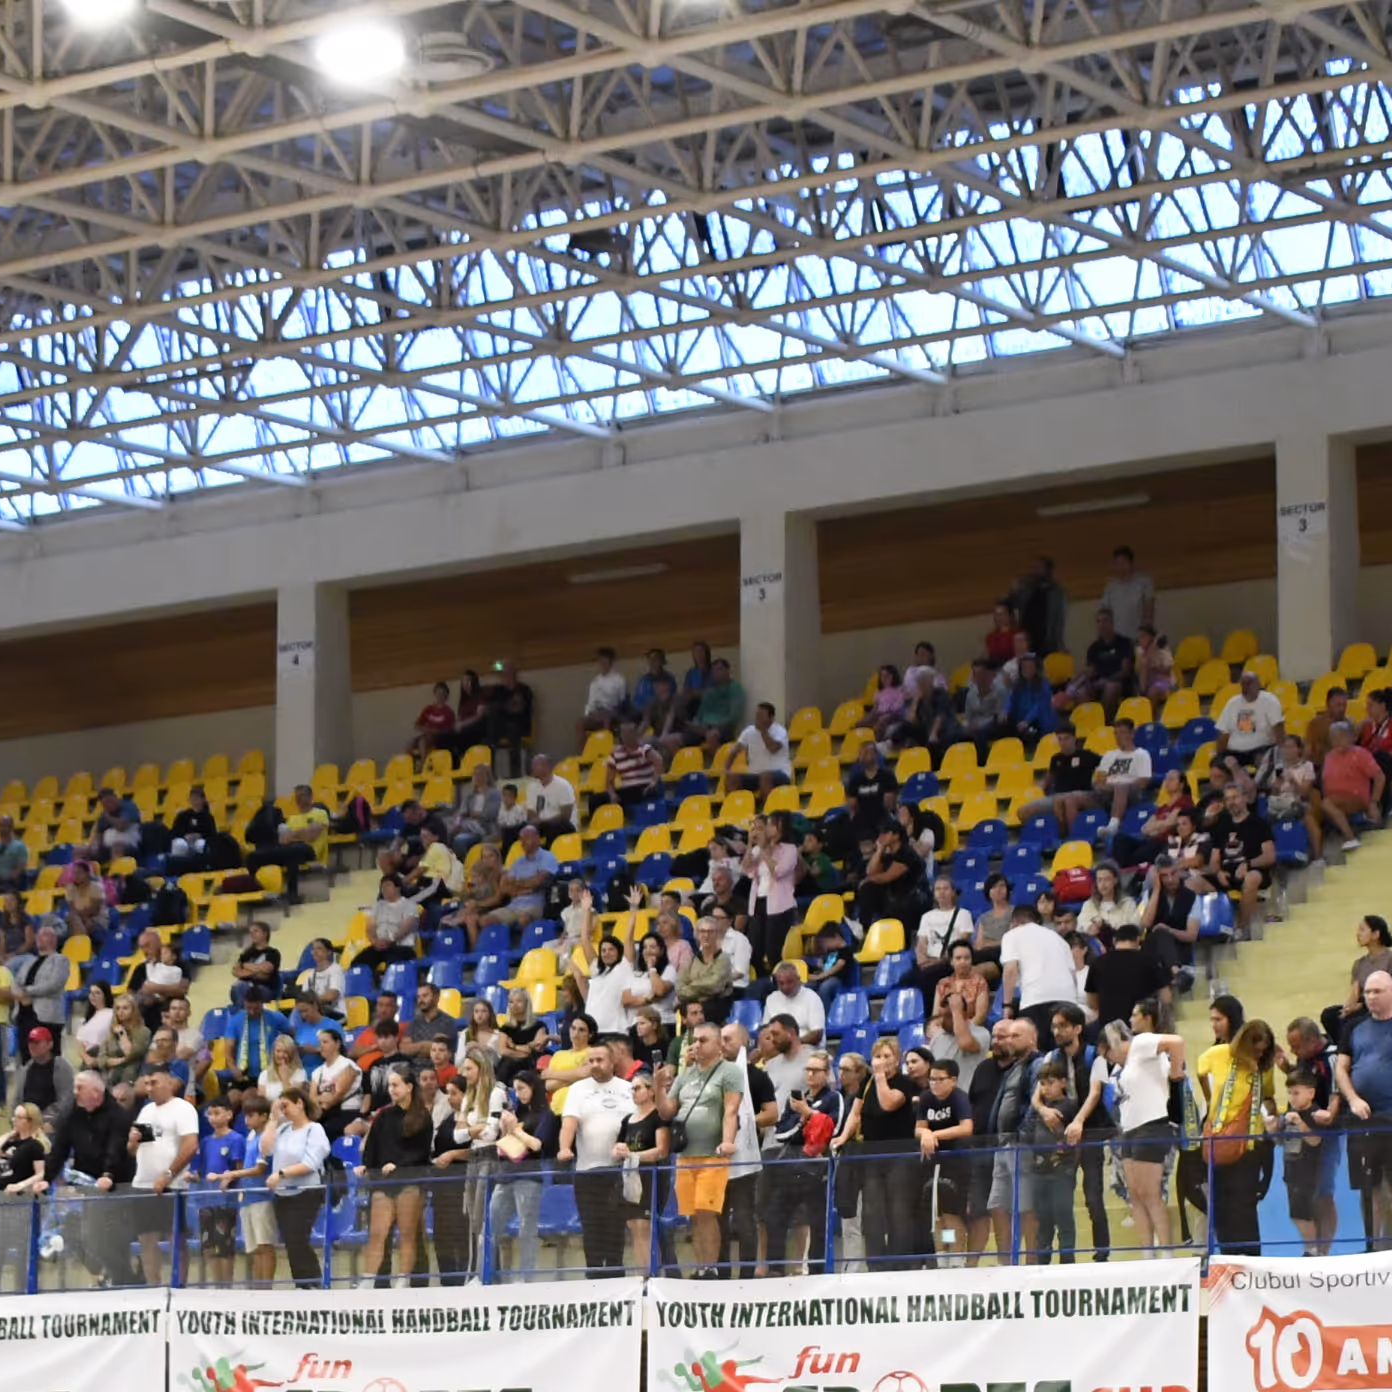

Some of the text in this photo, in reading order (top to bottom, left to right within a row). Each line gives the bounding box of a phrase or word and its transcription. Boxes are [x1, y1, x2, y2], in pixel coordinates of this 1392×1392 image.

[1280, 502, 1326, 516] SECTOR
[1299, 518, 1307, 532] 3
[1230, 1270, 1301, 1291] Clubul
[1309, 1267, 1390, 1293] Sportiv
[176, 1299, 635, 1335] YOUTH INTERNATIONAL HANDBALL TOURNAMENT
[655, 1283, 1192, 1329] YOUTH INTERNATIONAL HANDBALL TOURNAMENT
[42, 1308, 161, 1339] TOURNAMENT
[288, 1352, 352, 1382] fun
[788, 1345, 860, 1379] fun
[1248, 1316, 1324, 1390] 10
